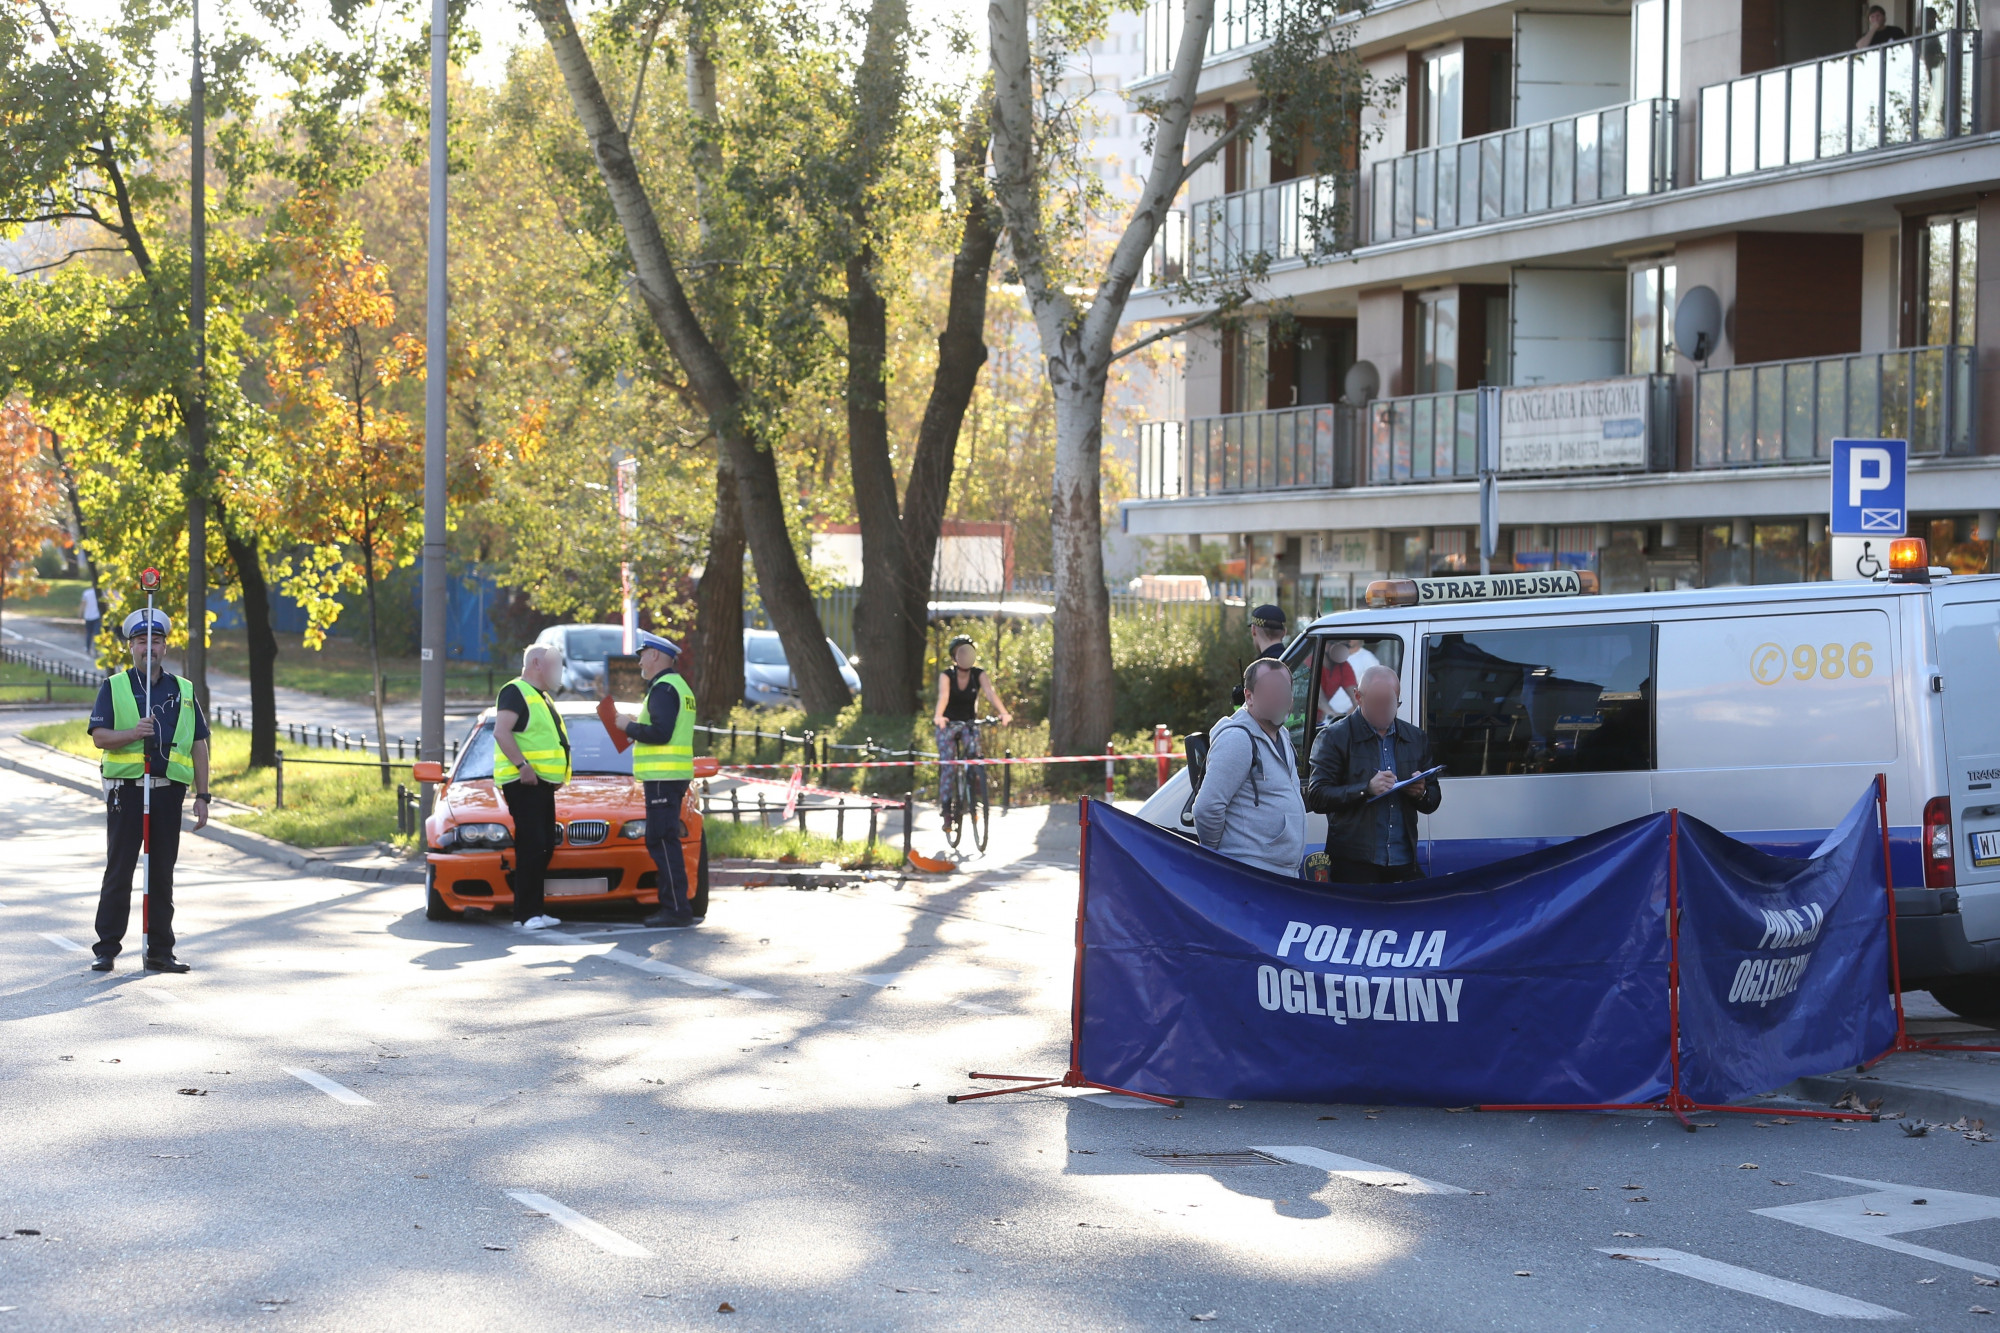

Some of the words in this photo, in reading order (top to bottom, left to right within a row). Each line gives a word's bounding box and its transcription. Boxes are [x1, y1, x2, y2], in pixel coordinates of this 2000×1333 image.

[1507, 390, 1576, 424] KANCELARIA
[1849, 447, 1891, 507] P
[1493, 576, 1577, 596] MIEJSKA
[1791, 641, 1874, 681] 986
[1276, 920, 1447, 968] POLICJA
[1257, 964, 1464, 1025] OGLĘDZINY
